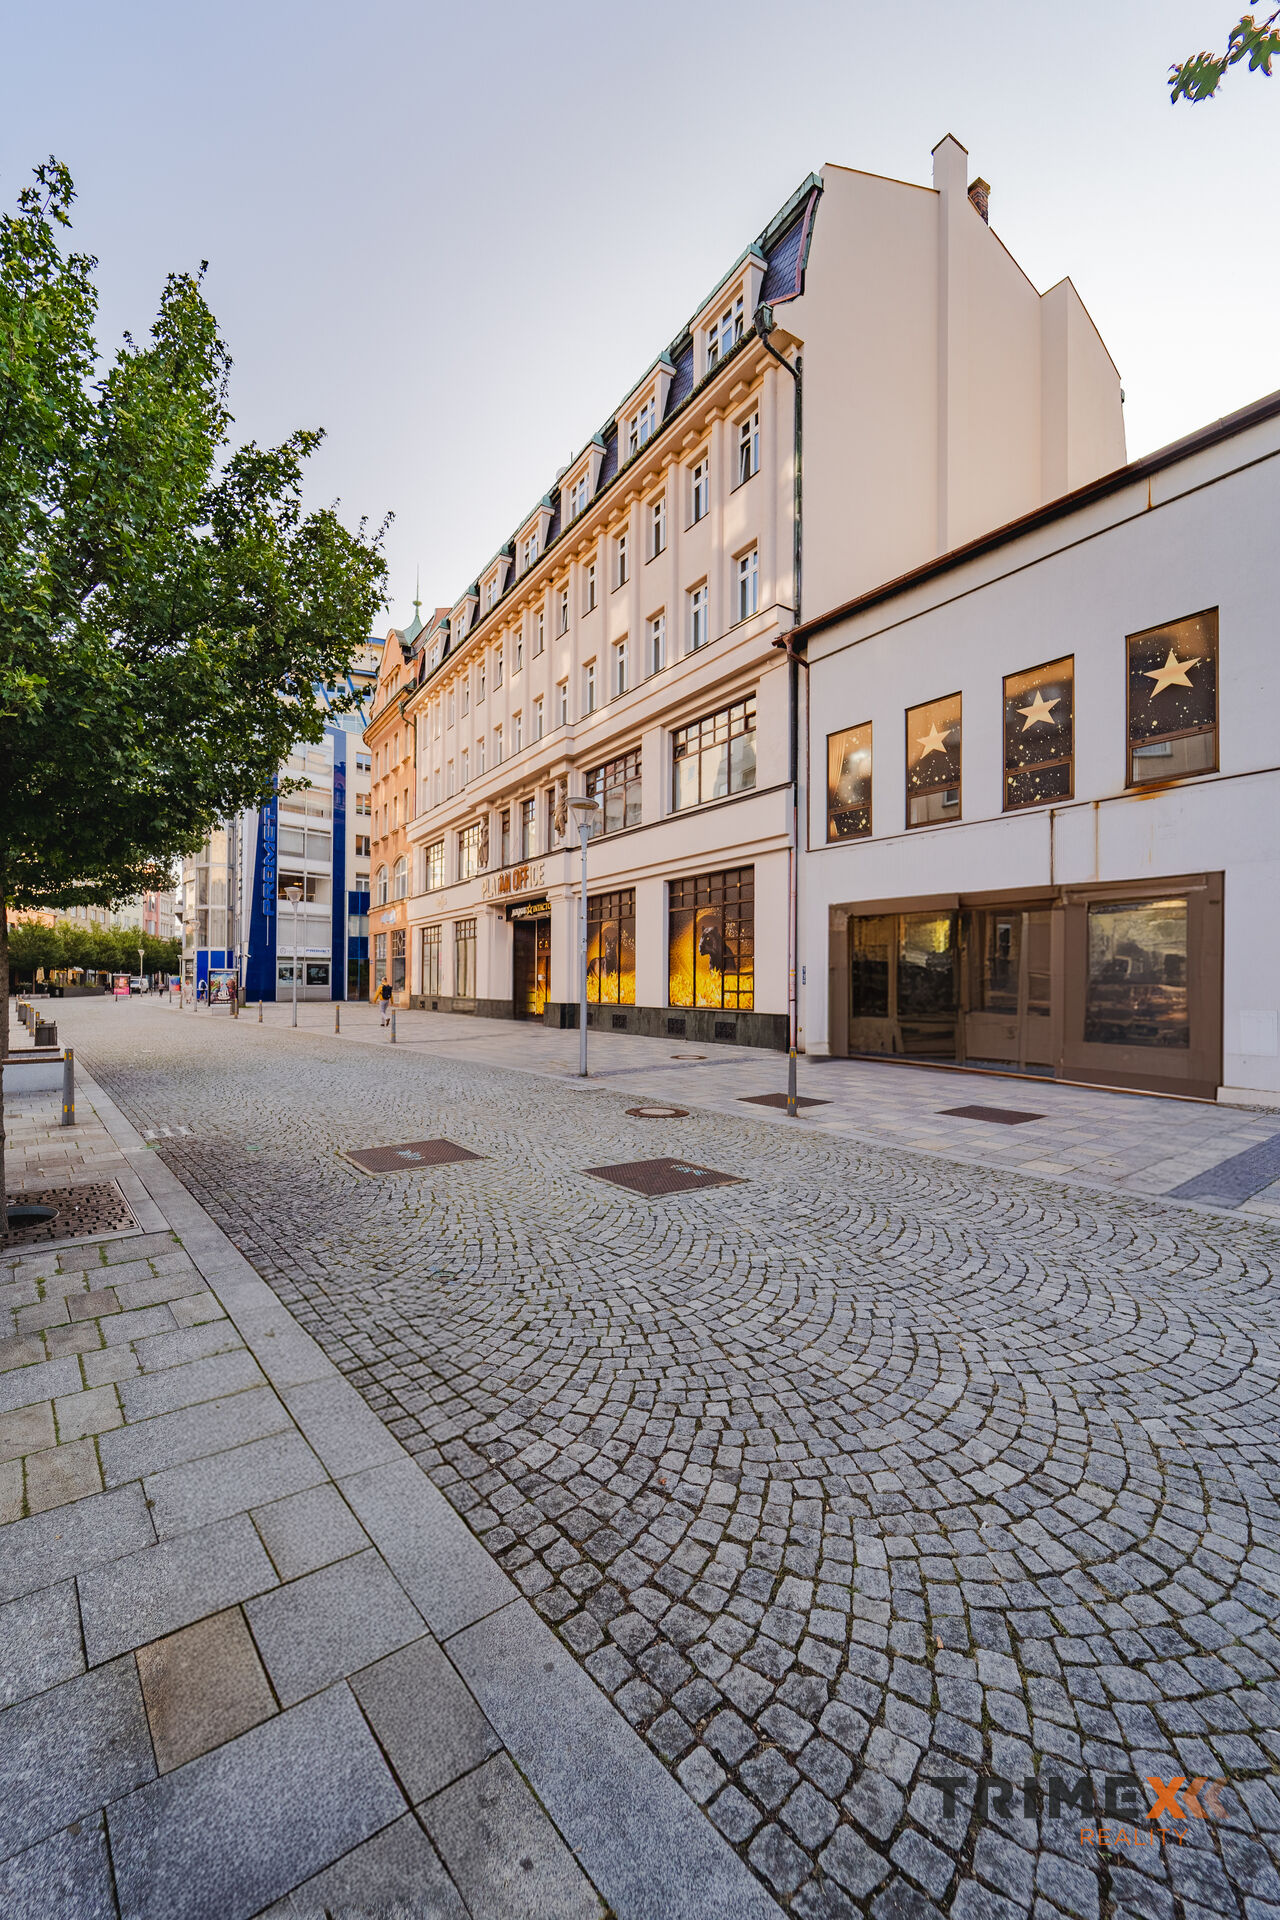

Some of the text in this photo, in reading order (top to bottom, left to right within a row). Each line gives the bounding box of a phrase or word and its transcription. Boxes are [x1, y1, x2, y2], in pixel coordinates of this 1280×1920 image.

[262, 807, 276, 916] PROMET
[482, 863, 544, 899] PLATAN OFFICE
